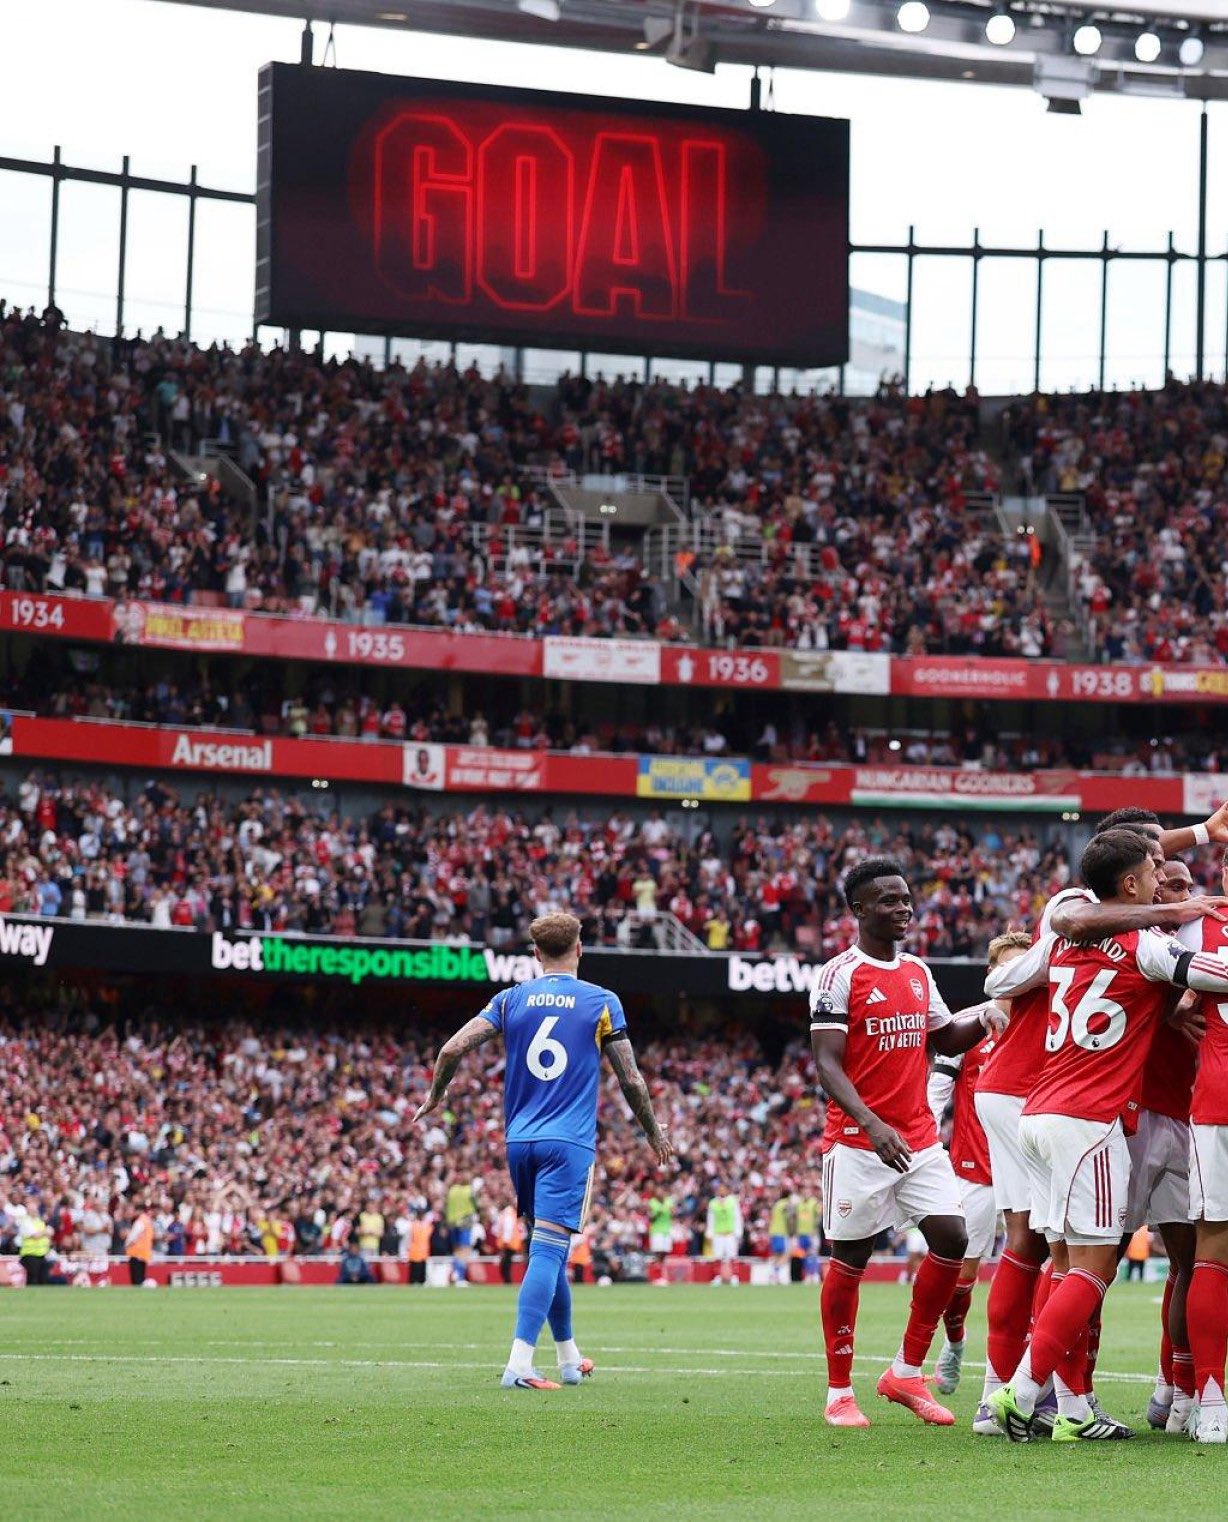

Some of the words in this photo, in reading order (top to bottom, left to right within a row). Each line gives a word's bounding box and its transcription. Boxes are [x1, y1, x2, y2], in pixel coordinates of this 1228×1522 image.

[374, 113, 752, 323] GOAL
[12, 599, 65, 629] 1934
[348, 632, 404, 661] 1935
[708, 656, 768, 683] 1936
[1073, 671, 1132, 696] 1938
[172, 734, 273, 770] Arsenal
[1056, 937, 1128, 963] ZUNDI
[728, 956, 819, 991] betw
[527, 993, 576, 1008] RODON
[1045, 966, 1128, 1051] 36
[865, 1011, 926, 1036] Emirate
[526, 1016, 568, 1081] 6
